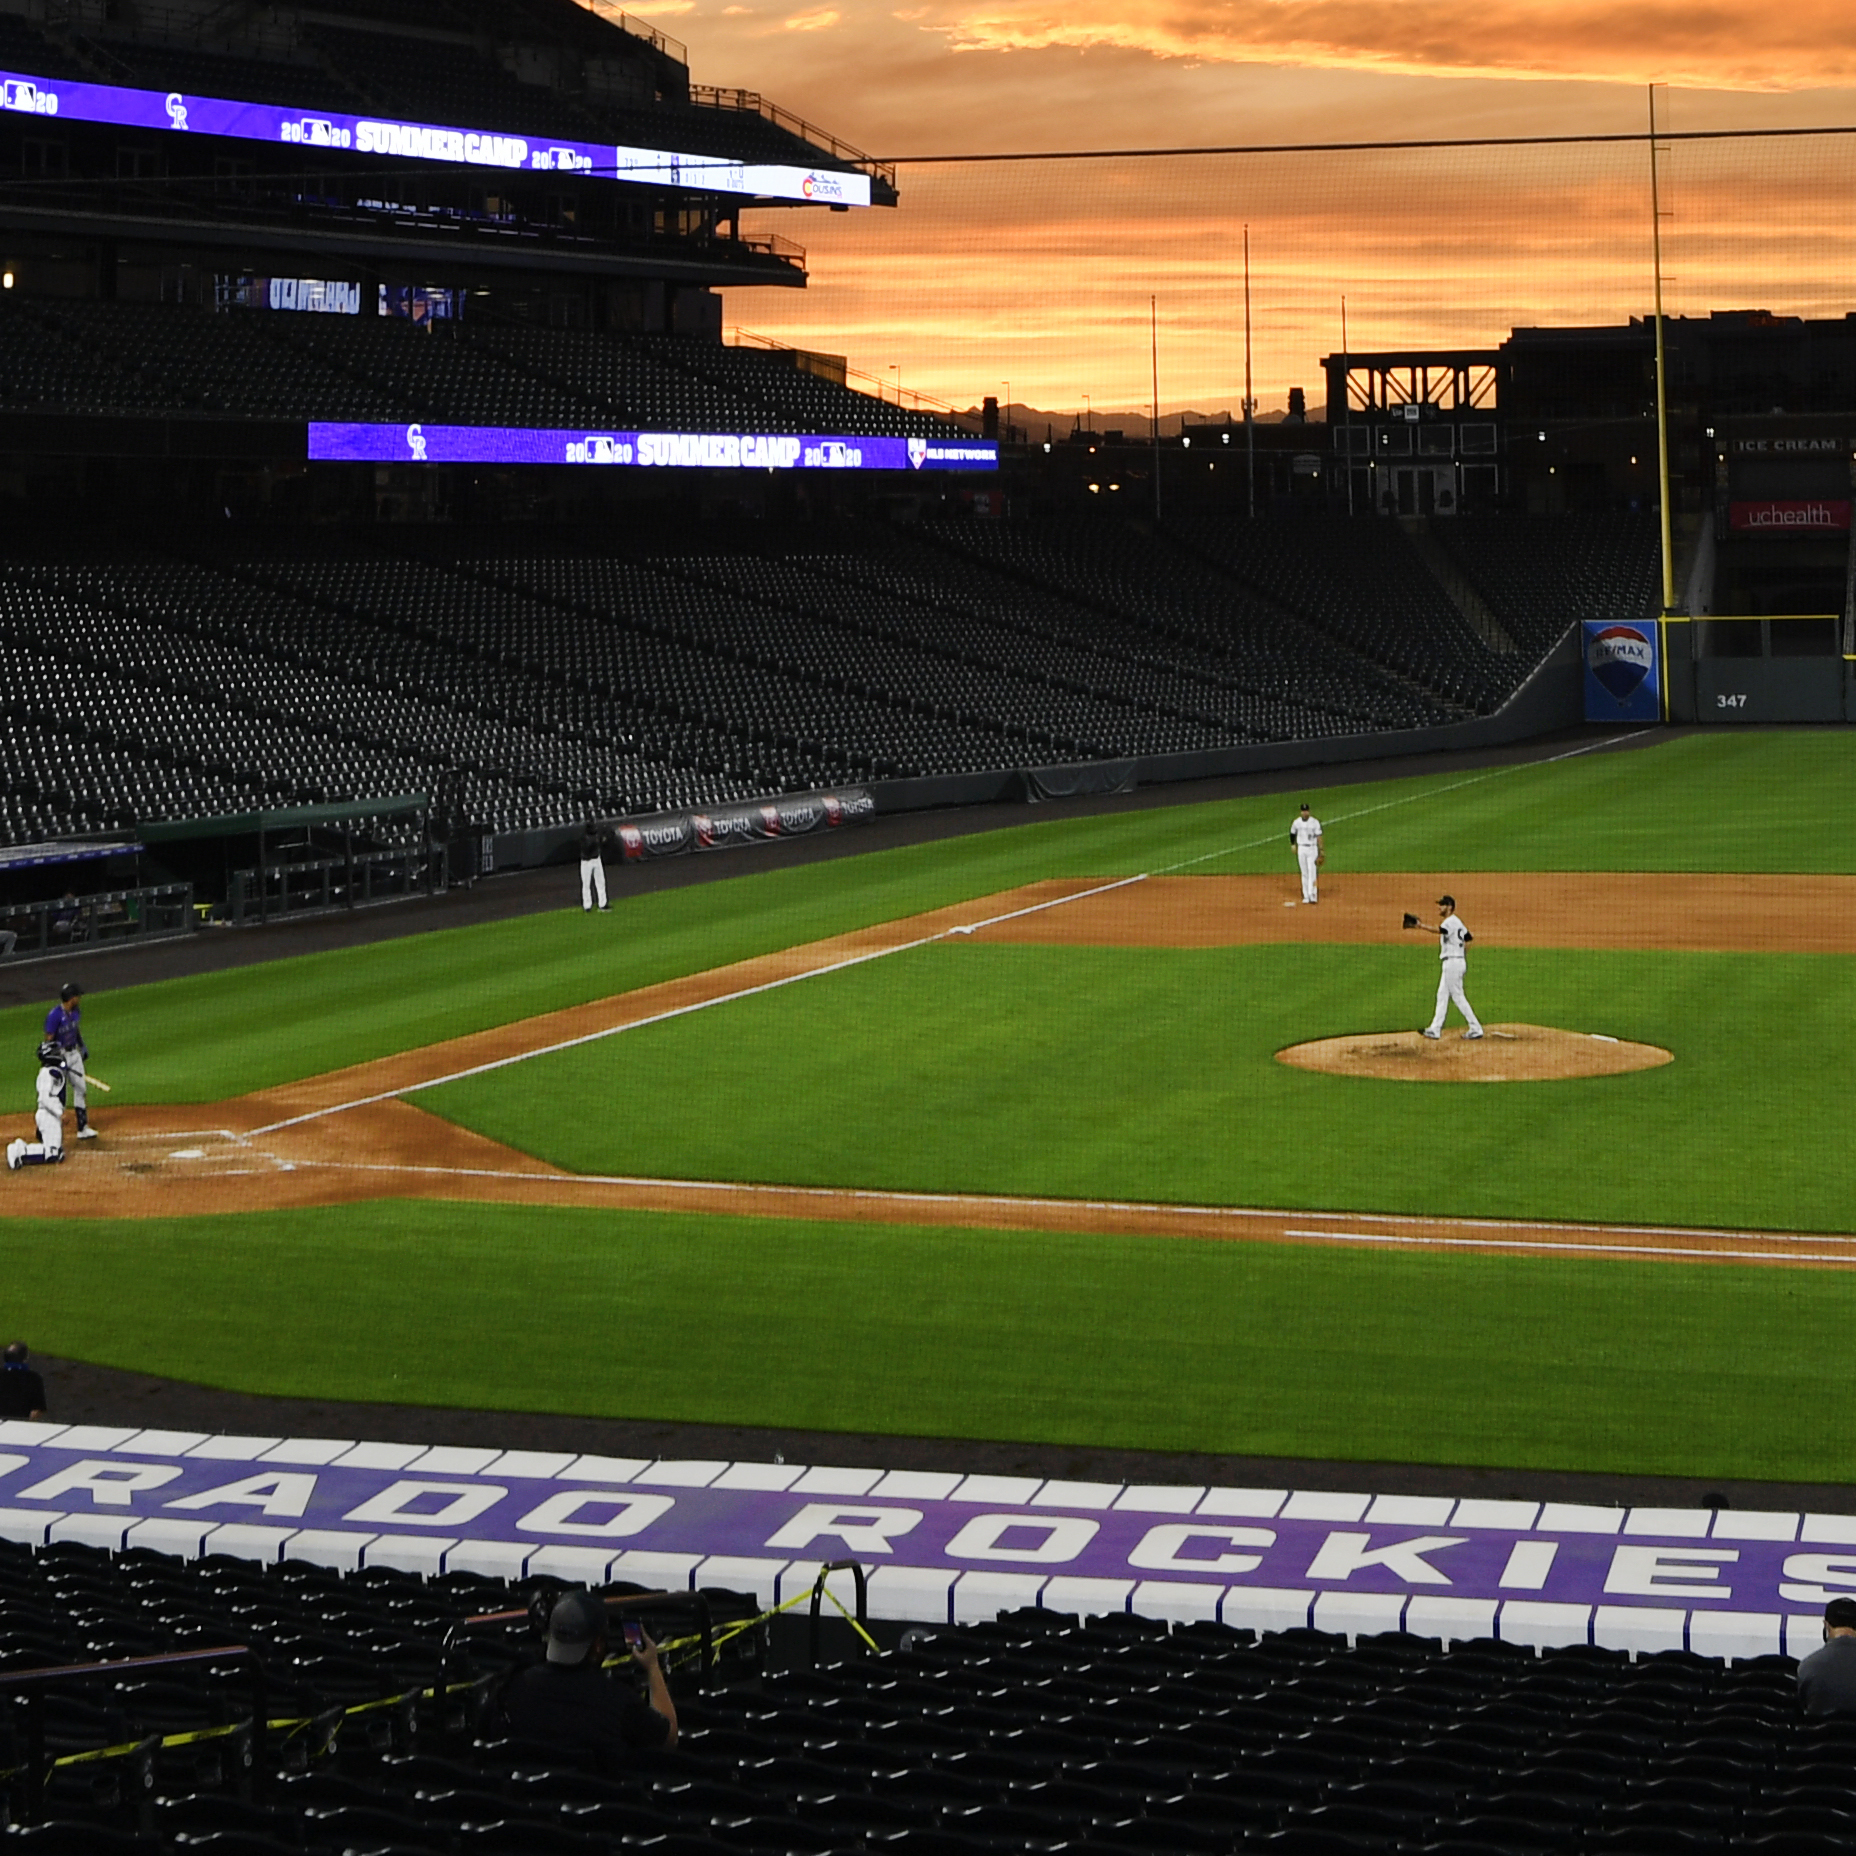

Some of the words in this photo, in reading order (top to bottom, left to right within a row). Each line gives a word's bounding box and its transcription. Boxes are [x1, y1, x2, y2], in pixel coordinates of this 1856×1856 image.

[1740, 440, 1767, 451] ICE
[1774, 439, 1837, 450] CREAM
[1748, 504, 1831, 527] uchealth
[1596, 644, 1644, 660] RE/MAX
[1716, 694, 1747, 708] 347
[714, 817, 751, 835] TOYOTA
[780, 808, 816, 826] TOYOTA
[642, 827, 683, 845] TOYOTA
